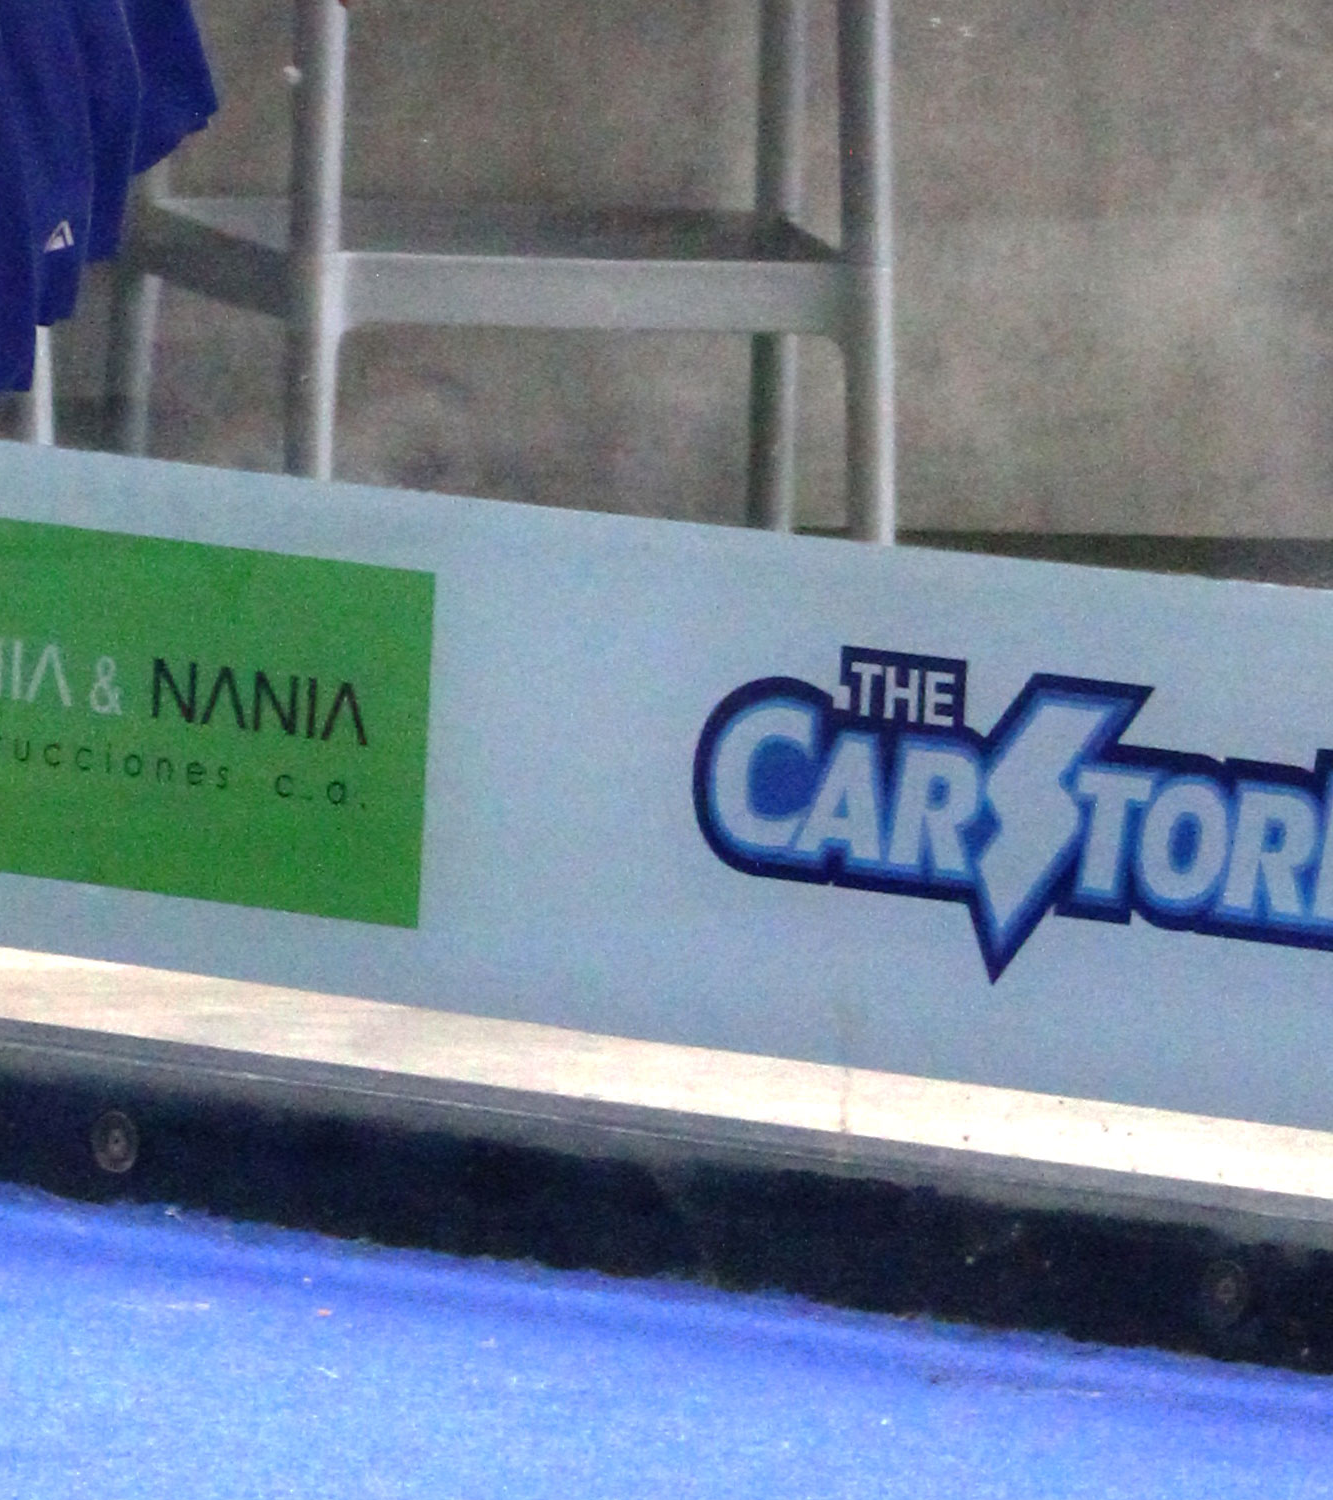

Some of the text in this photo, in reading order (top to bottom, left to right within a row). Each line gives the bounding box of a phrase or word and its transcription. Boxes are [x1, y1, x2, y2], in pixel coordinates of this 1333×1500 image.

[88, 655, 124, 716] &
[150, 656, 368, 747] NANIA
[850, 660, 957, 727] THE
